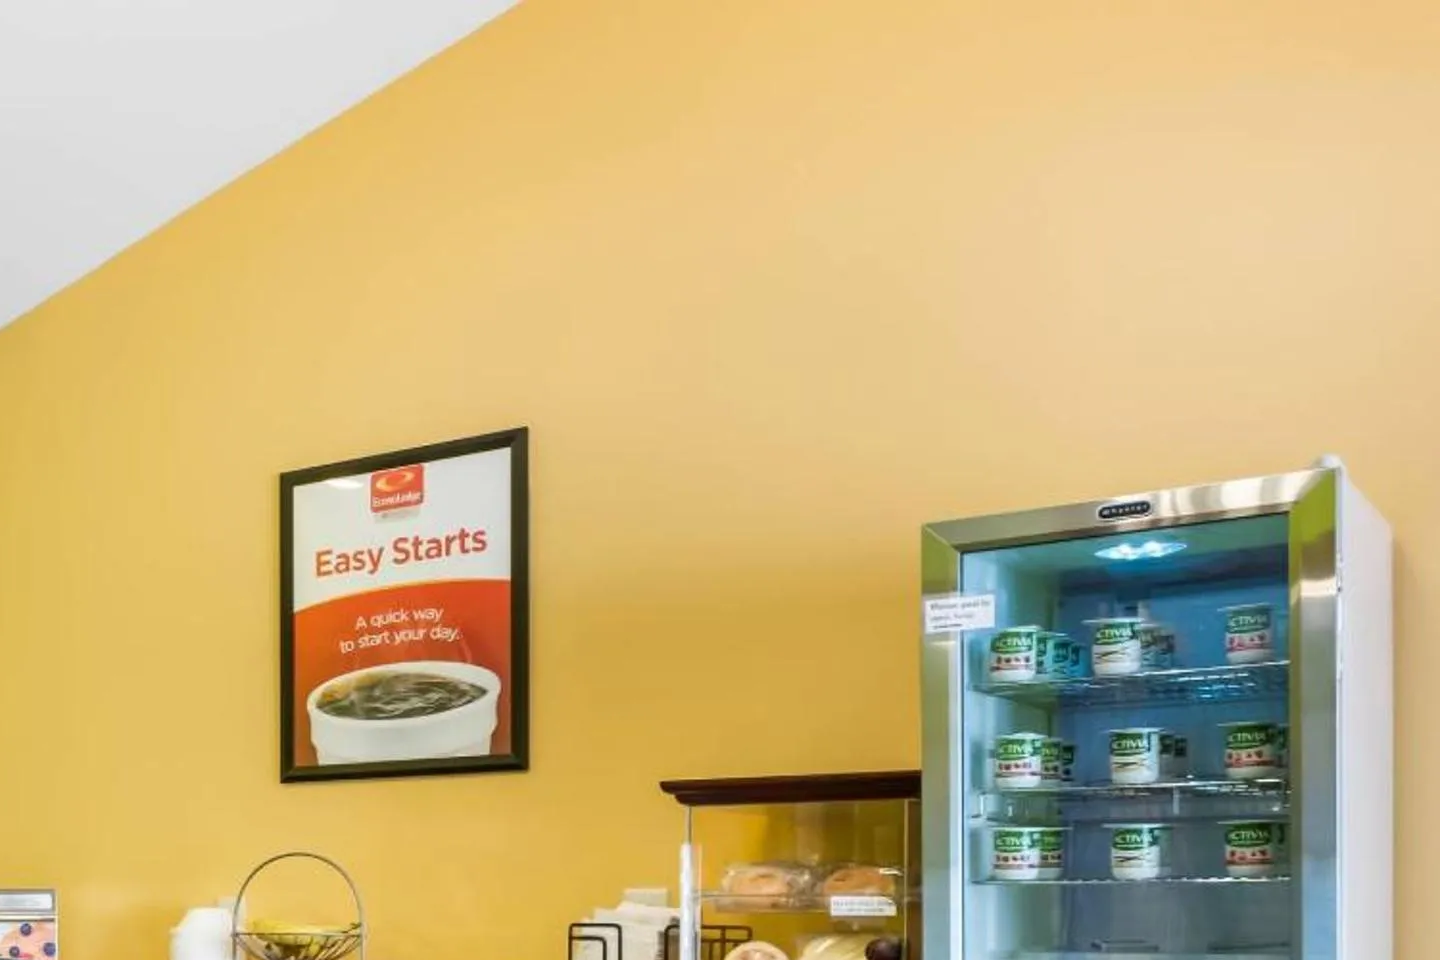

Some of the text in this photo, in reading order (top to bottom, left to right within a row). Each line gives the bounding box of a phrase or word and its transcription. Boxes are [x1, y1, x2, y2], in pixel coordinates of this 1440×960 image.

[315, 527, 488, 577] Easy Starts
[355, 607, 444, 630] A quick way
[339, 623, 461, 654] to start your day.
